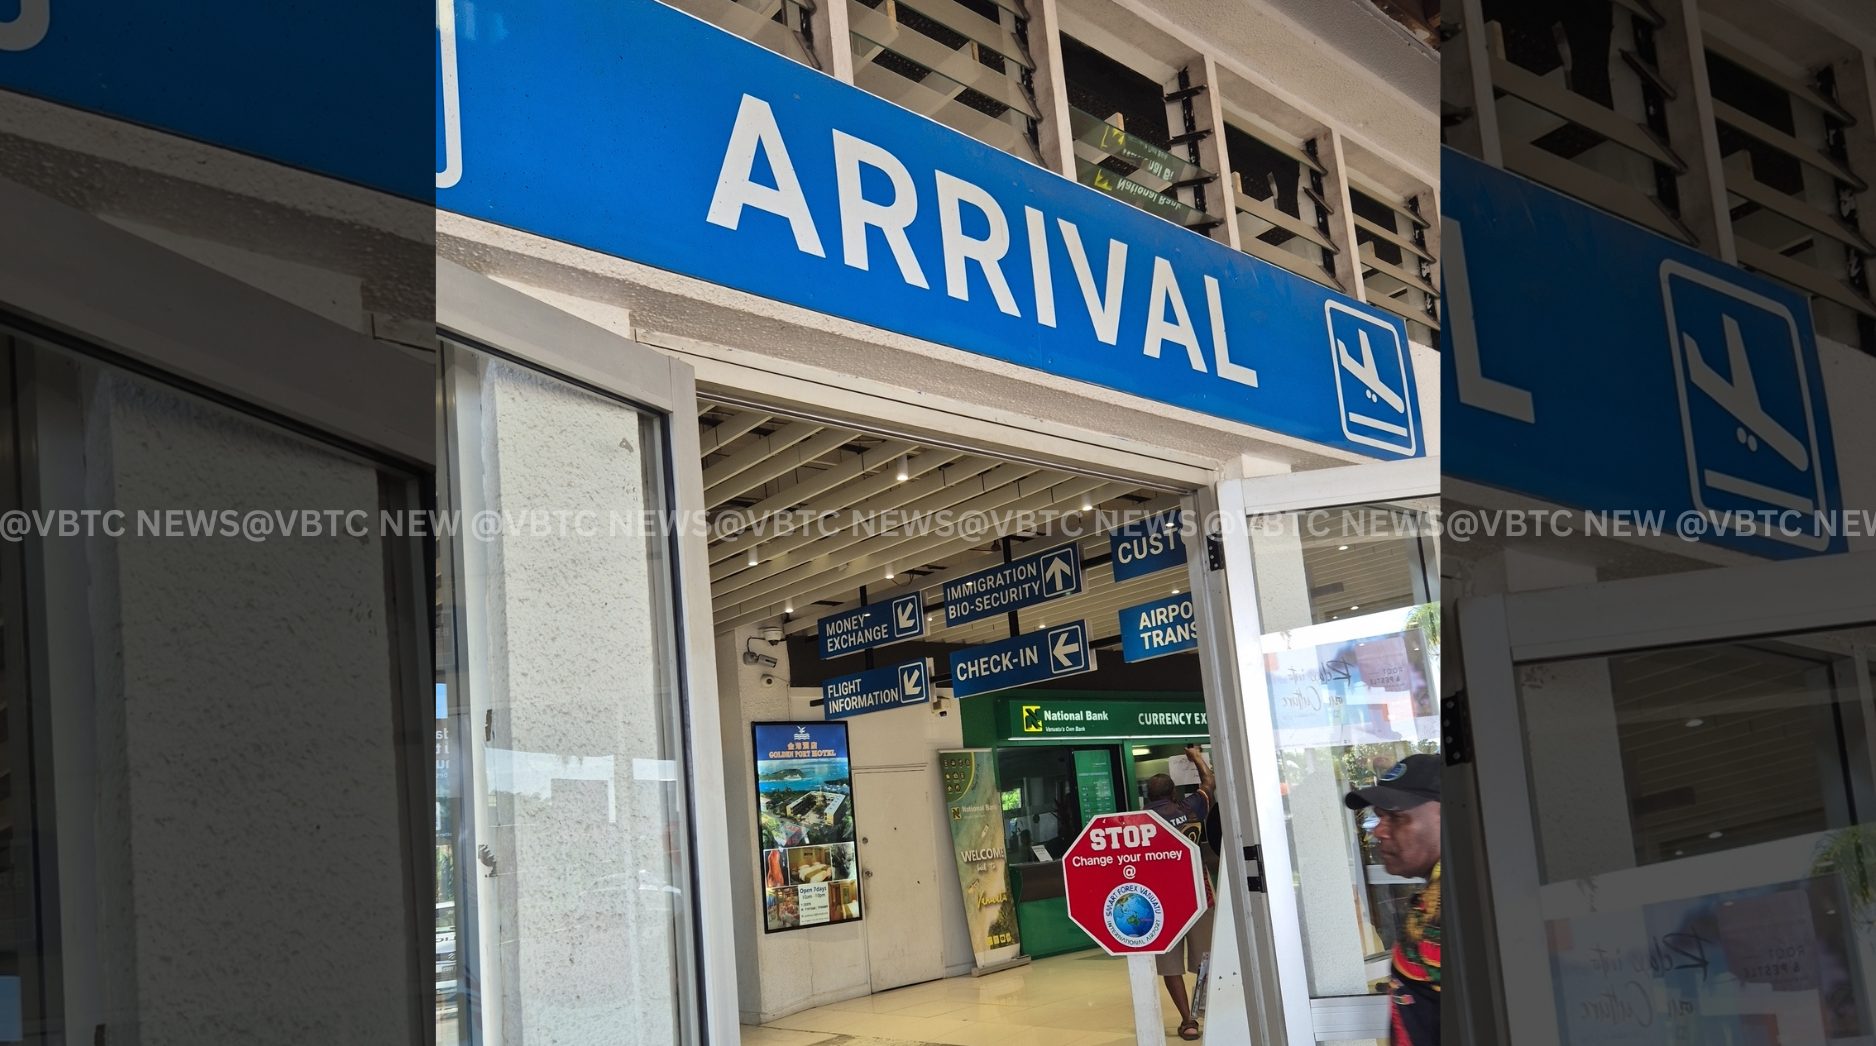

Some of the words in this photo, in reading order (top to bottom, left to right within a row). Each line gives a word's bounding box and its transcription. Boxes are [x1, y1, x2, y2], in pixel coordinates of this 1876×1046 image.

[706, 93, 1259, 388] ARRIVAL
[1117, 526, 1180, 564] CUST
[946, 562, 1038, 601] IMMIGRATION
[948, 580, 1040, 619] BIO-SECURITY
[825, 614, 866, 637] MONEY
[827, 624, 889, 653] EXCHANGE
[956, 645, 1039, 681] CHECK-IN
[827, 678, 862, 698] FLIGHT
[828, 687, 899, 714] INFORMATION
[1043, 710, 1084, 721] National
[1085, 710, 1109, 721] Bank
[1138, 712, 1192, 725] CURRENCY
[1194, 712, 1207, 725] EX
[1170, 815, 1188, 827] TAXI
[1089, 823, 1157, 851] STOP
[960, 848, 1005, 863] WELCOME
[1072, 855, 1114, 867] Change
[1117, 853, 1142, 866] your
[1145, 850, 1183, 861] money
[1123, 865, 1137, 880] @
[1105, 892, 1118, 917] SMART
[1117, 884, 1138, 896] FOREX
[1140, 886, 1162, 915] VANUATU
